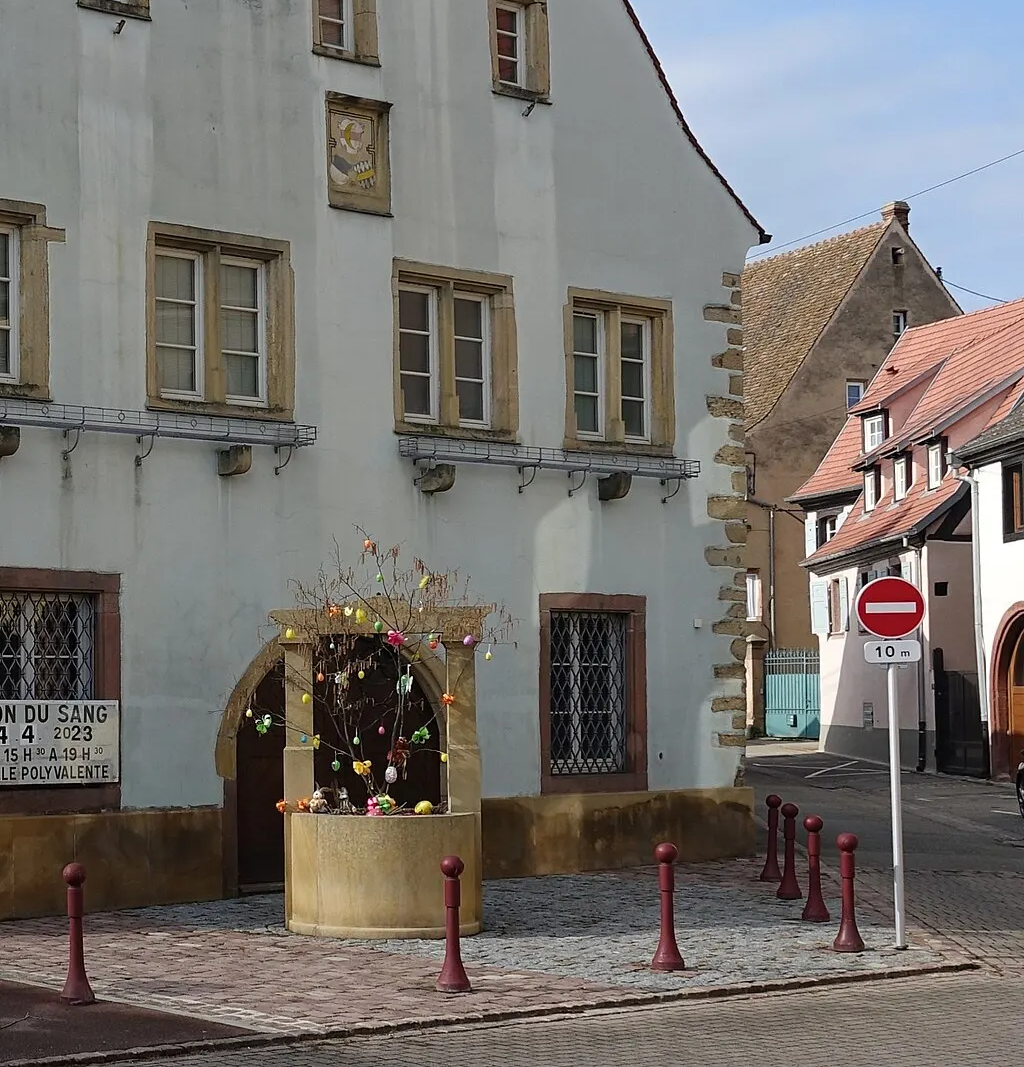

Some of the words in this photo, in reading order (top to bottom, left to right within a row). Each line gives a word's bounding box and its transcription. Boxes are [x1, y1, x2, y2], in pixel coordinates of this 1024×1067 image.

[875, 646, 895, 657] 10
[24, 704, 49, 723] DU
[57, 704, 108, 723] SANG
[53, 725, 93, 742] 2023
[3, 748, 19, 762] 15
[23, 747, 32, 762] H
[36, 747, 46, 756] 30
[48, 747, 58, 762] A
[62, 747, 77, 761] 19
[82, 747, 90, 761] H
[94, 746, 104, 755] 30
[21, 764, 109, 781] POLYVALENTE
